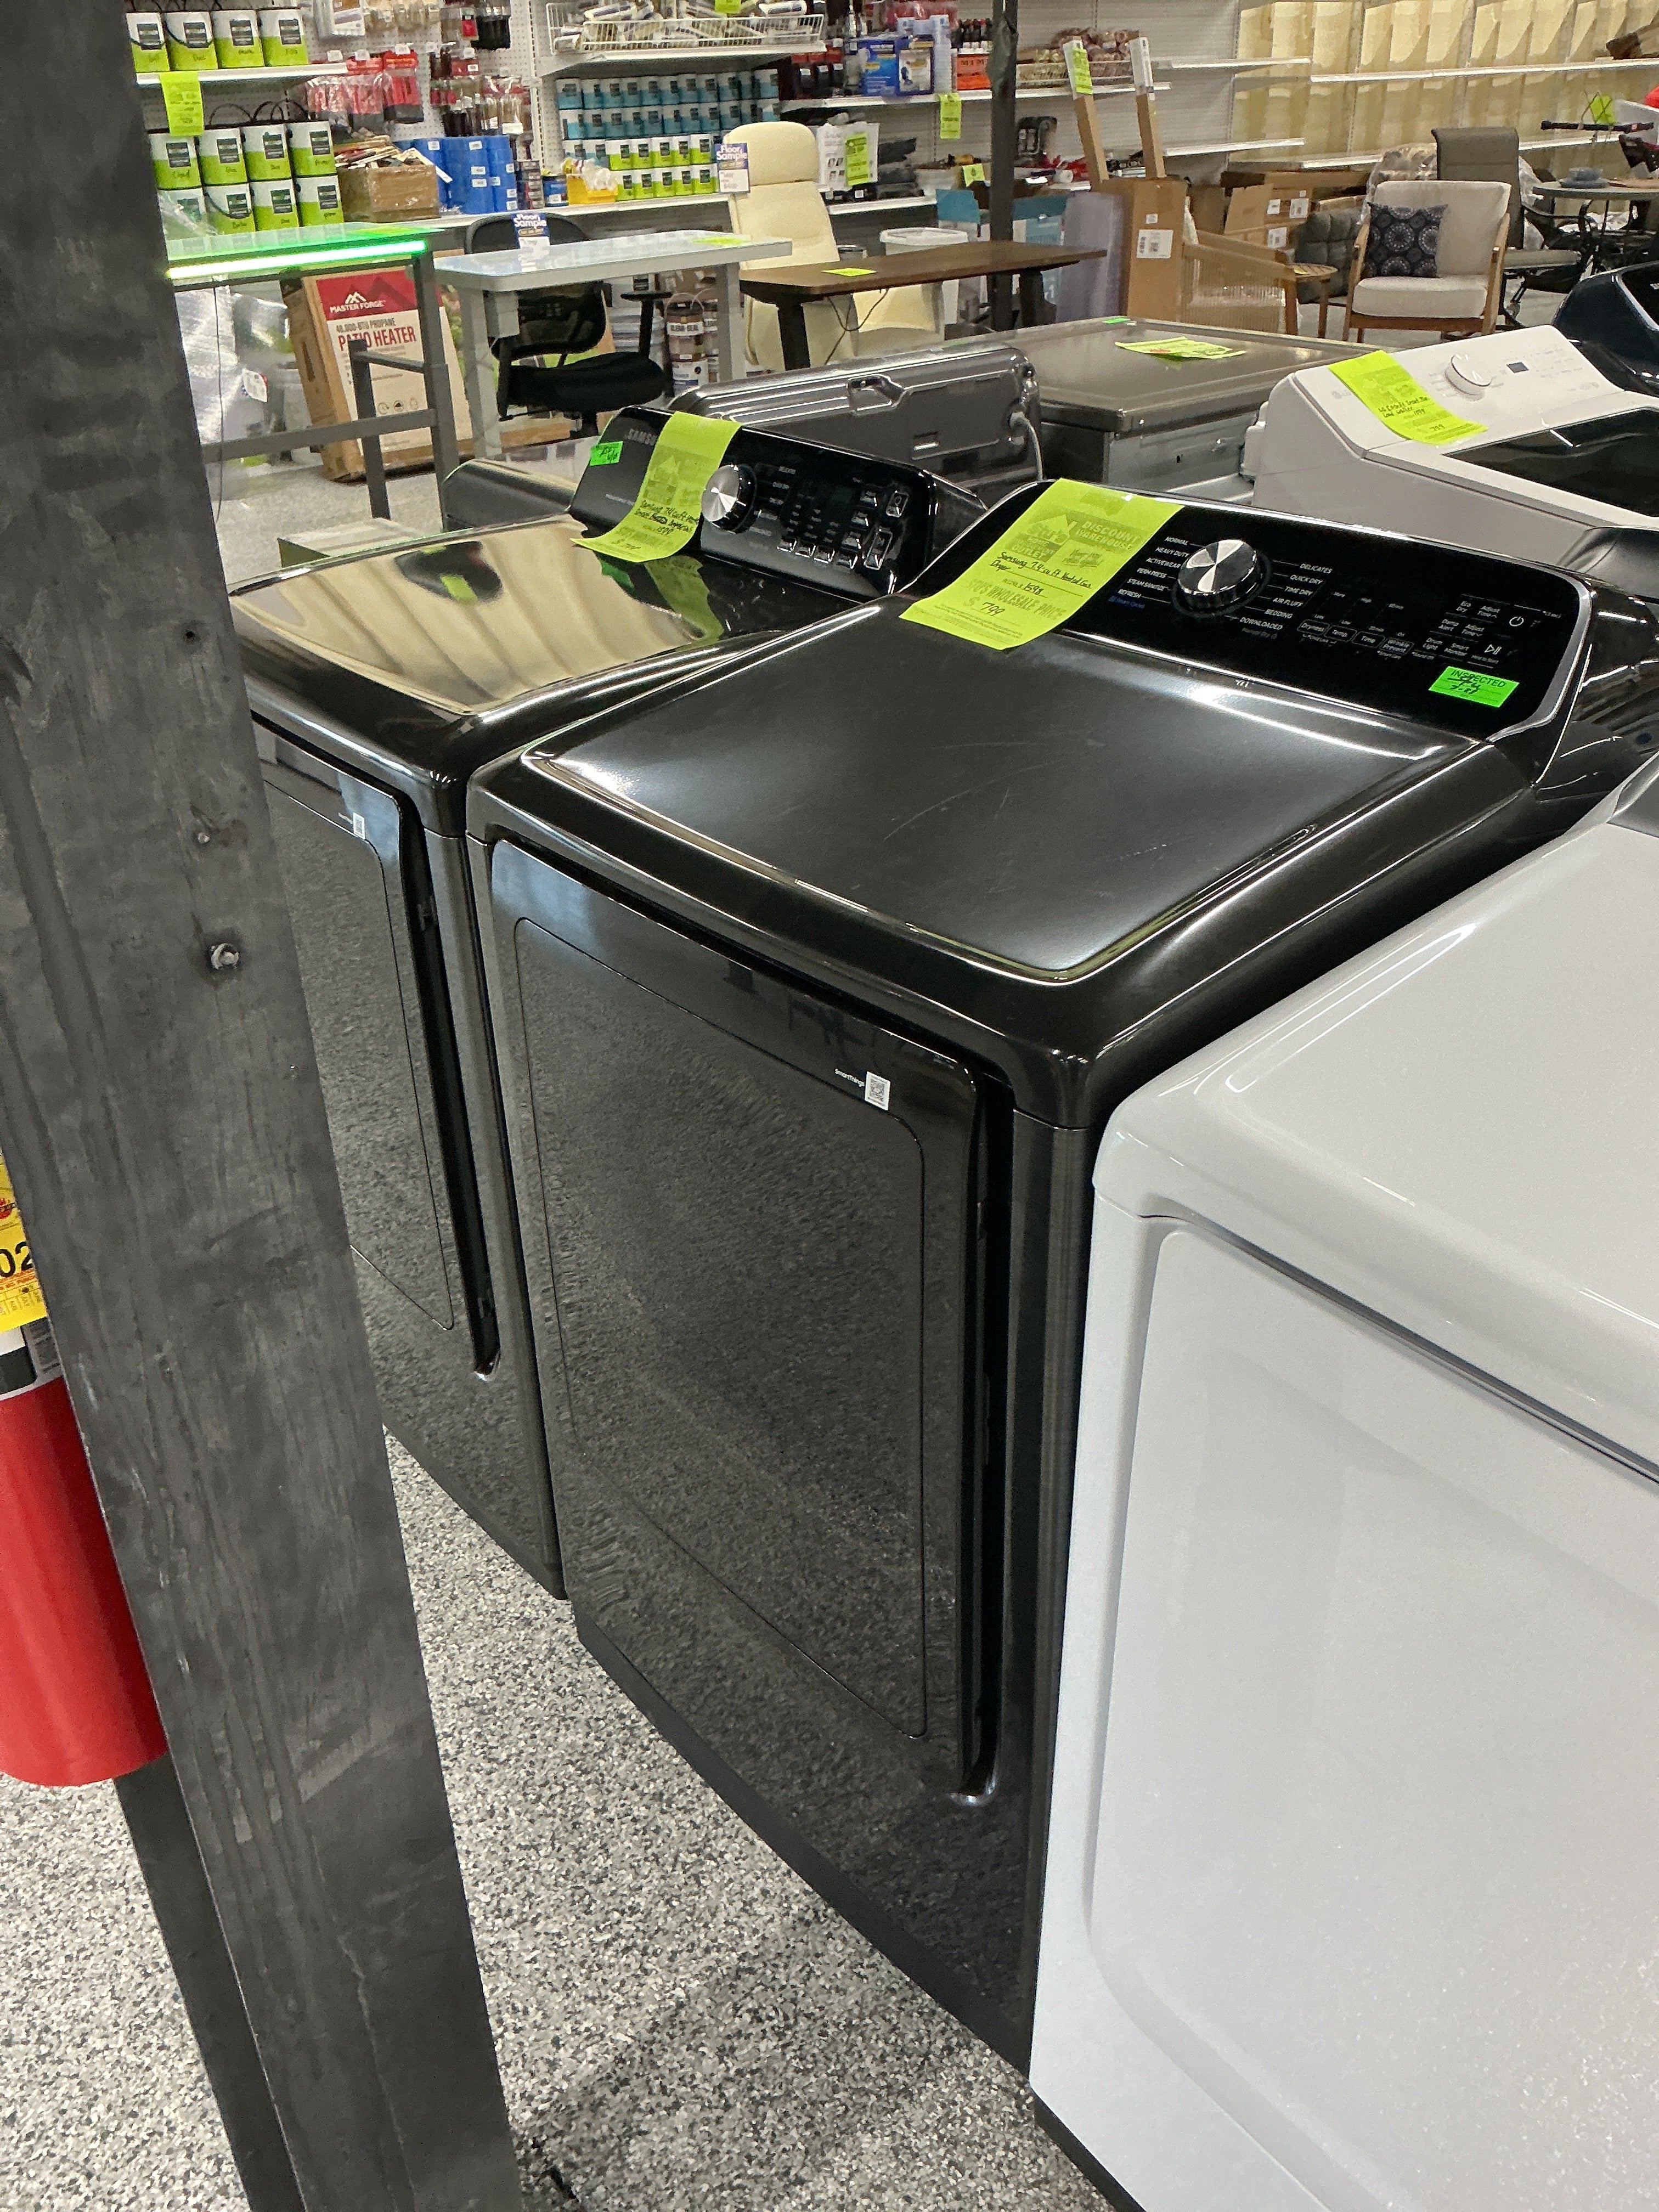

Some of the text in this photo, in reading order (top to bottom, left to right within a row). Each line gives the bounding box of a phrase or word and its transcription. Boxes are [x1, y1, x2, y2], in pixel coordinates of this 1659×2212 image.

[720, 145, 743, 153] Floor
[716, 151, 747, 161] Sample
[514, 218, 547, 229] Sample
[330, 300, 383, 313] MASTER FORGE
[370, 317, 396, 328] PROPANE
[373, 326, 416, 347] HEATER
[1082, 521, 1141, 543] DISCOUNT
[1076, 528, 1133, 550] WAREHOUSE
[1164, 536, 1188, 546] NORMAL
[1012, 544, 1046, 558] OUTLET
[1146, 557, 1181, 568] ACTIVEWEAR
[1300, 563, 1333, 574] DELICATES
[1118, 589, 1142, 598] REFRESH
[988, 585, 1041, 612] WHOLESALE
[1034, 603, 1066, 620] PRICE
[980, 601, 1005, 617] 799
[1265, 608, 1293, 619] BEDDING
[1240, 617, 1283, 630] DOWNLOADED
[1331, 629, 1348, 637] Temp
[1361, 635, 1376, 644] Time
[1450, 670, 1507, 687] INSPECTED
